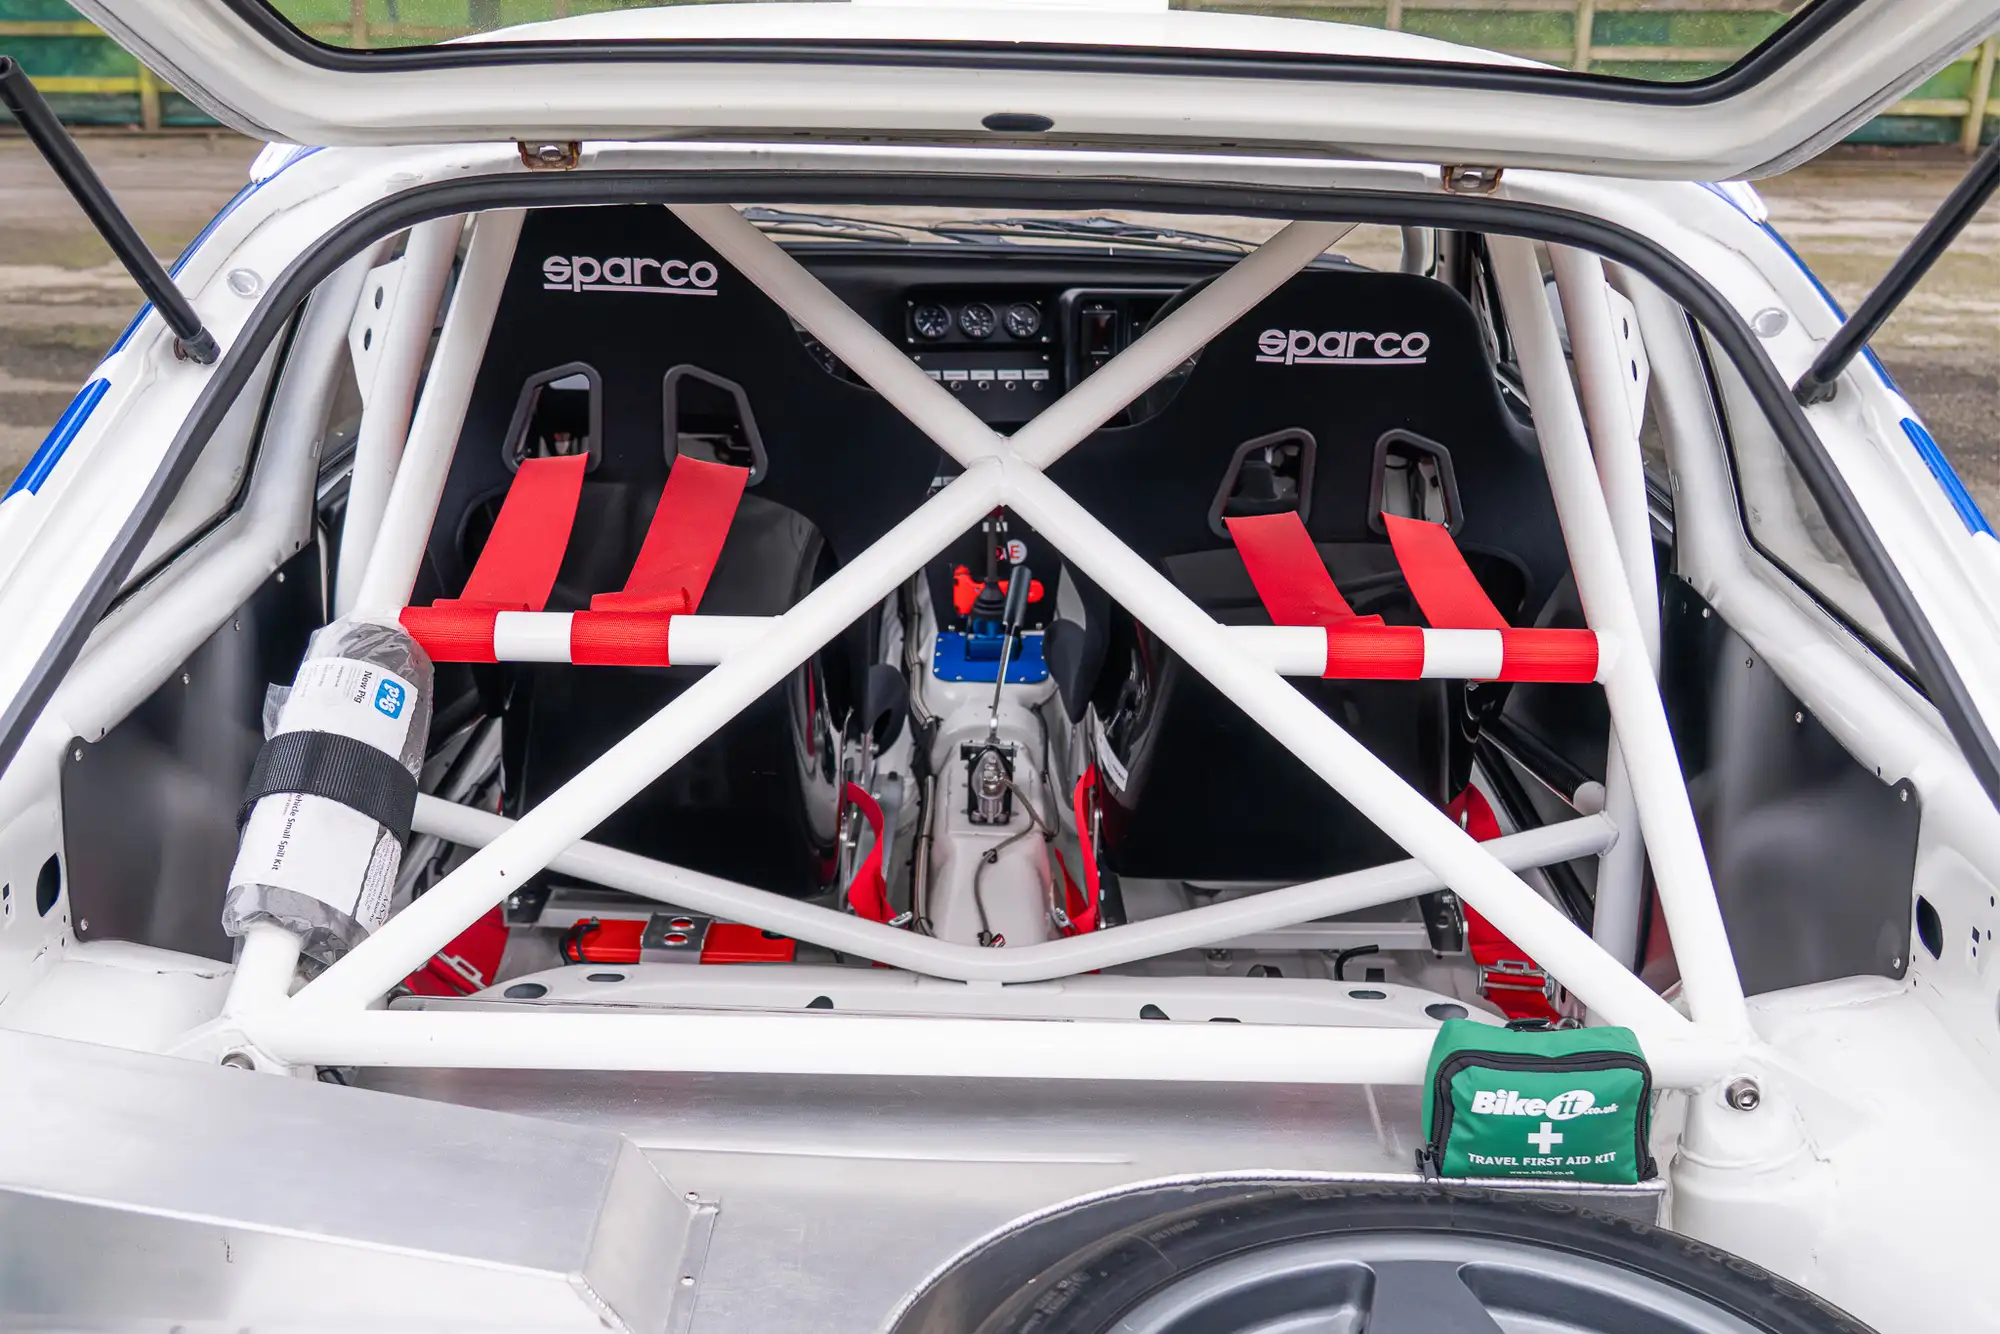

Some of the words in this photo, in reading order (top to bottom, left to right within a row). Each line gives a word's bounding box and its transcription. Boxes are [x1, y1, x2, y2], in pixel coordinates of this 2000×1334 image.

[542, 255, 718, 294] sparco
[1257, 329, 1430, 365] sparco
[360, 670, 373, 690] New
[353, 690, 366, 704] Pig
[378, 682, 400, 714] pig
[282, 818, 296, 839] Small
[276, 840, 288, 858] Spill
[271, 858, 282, 870] Kit
[1468, 1152, 1519, 1166] TRAVEL
[1522, 1156, 1563, 1166] FIRST
[1566, 1155, 1592, 1166] AID
[1595, 1151, 1617, 1164] KIT
